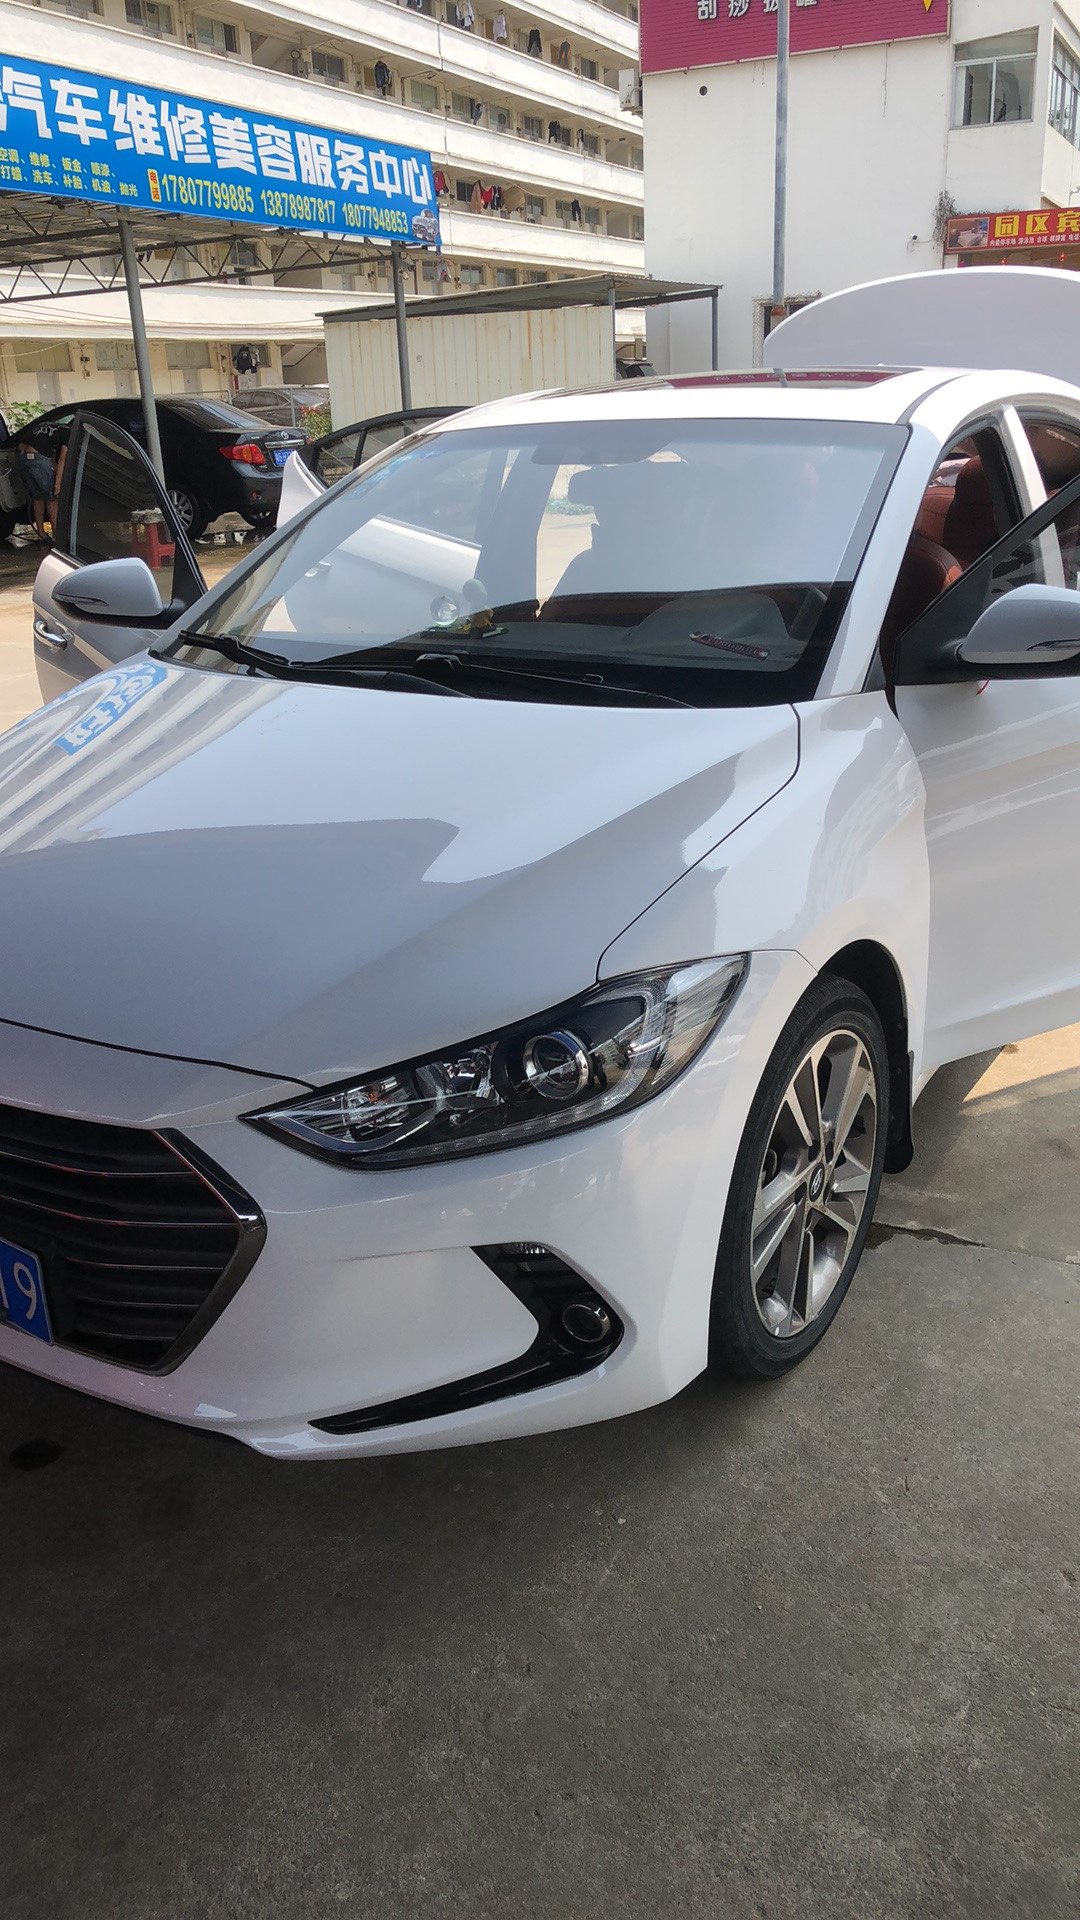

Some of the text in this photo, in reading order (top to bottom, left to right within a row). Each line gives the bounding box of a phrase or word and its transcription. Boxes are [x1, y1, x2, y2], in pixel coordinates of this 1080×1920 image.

[0, 66, 432, 206] 汽车维修美容服务中心
[162, 174, 409, 234] 17807799885 13878987817 18077948853
